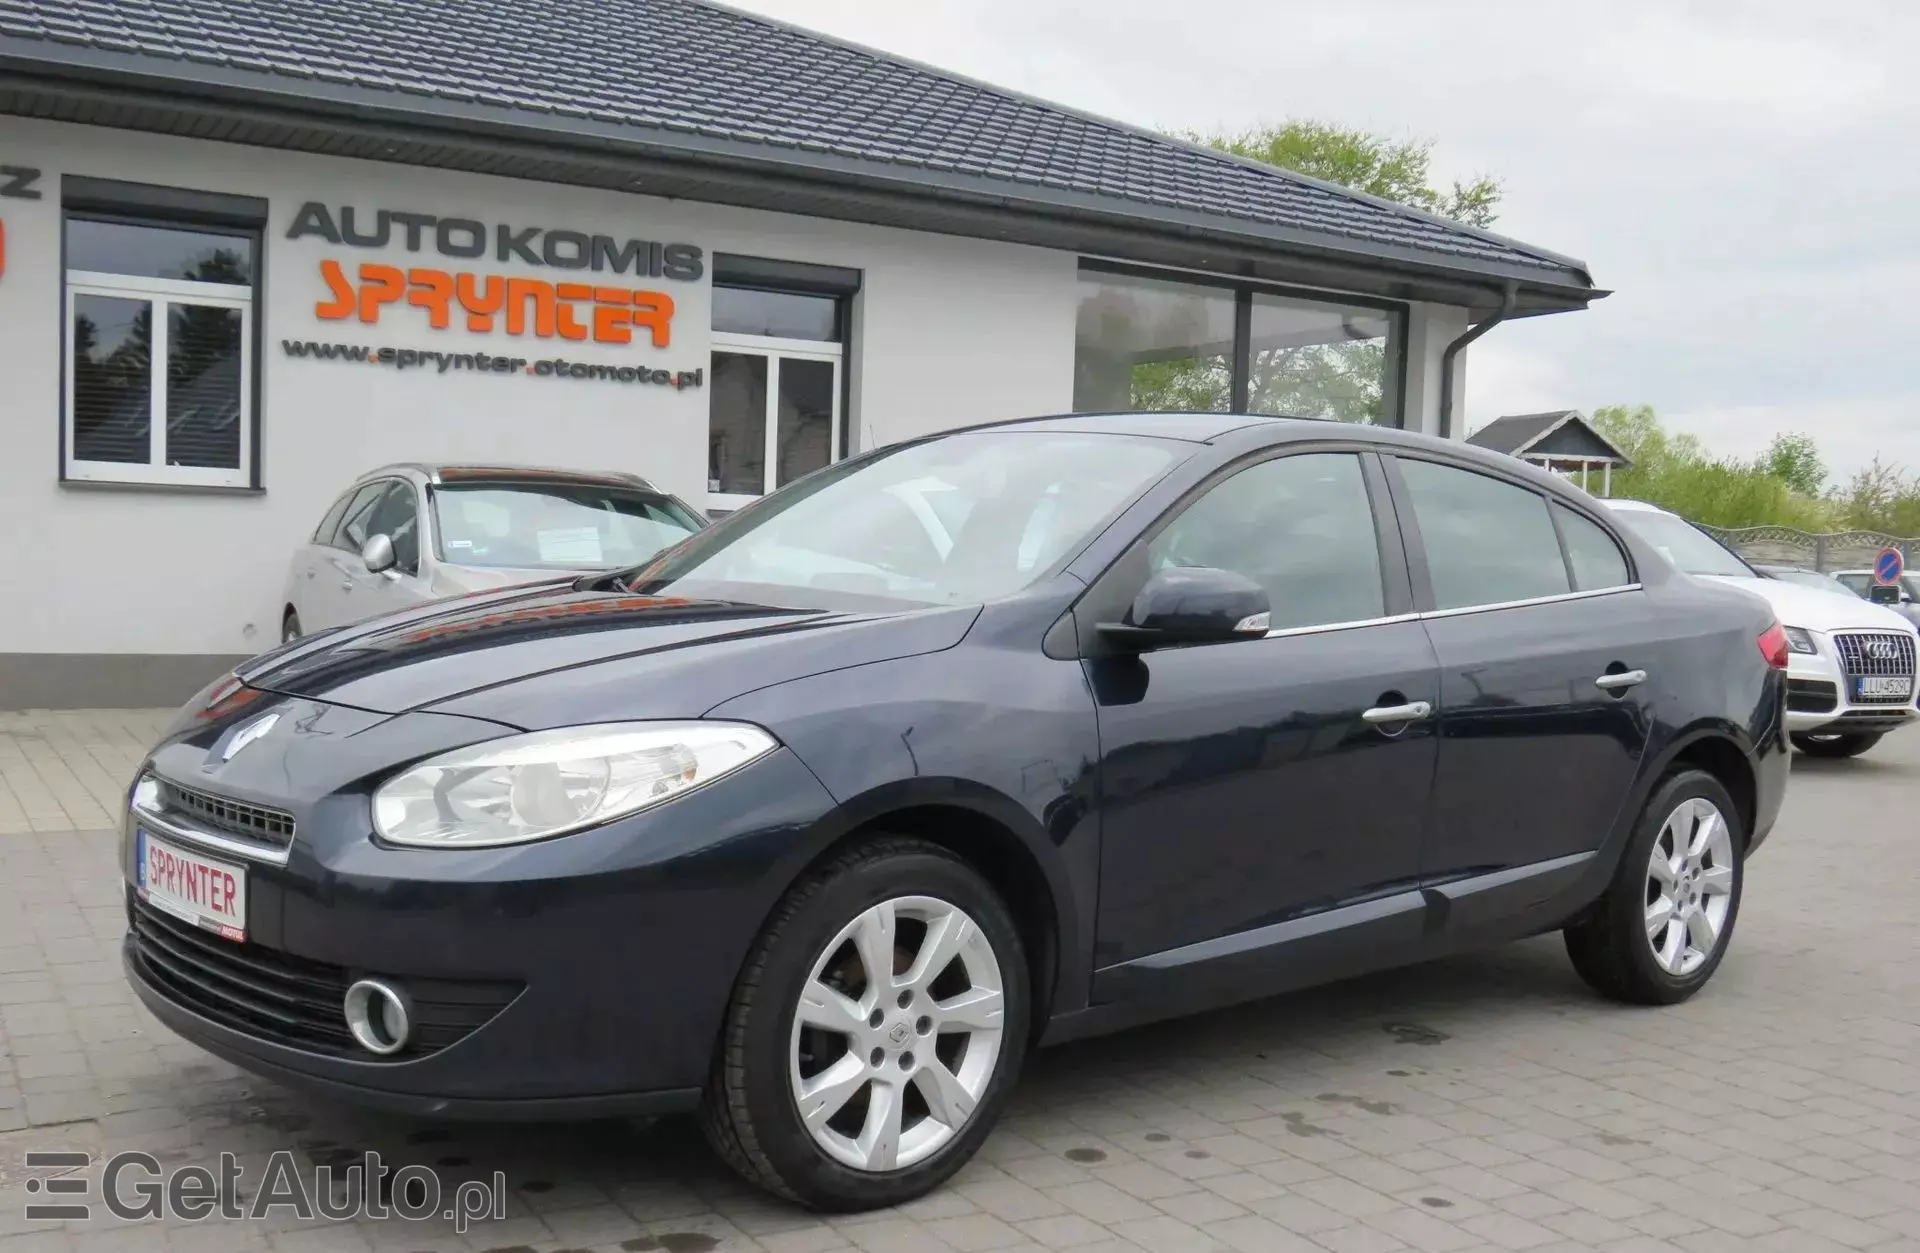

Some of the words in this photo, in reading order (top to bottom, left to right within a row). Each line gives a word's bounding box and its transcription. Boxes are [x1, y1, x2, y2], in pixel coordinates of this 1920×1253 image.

[285, 201, 487, 259] AUTO
[497, 223, 704, 282] KOMIS
[315, 259, 675, 348] SPRYNTER
[281, 339, 703, 392] www.sprynter.otomoto.pl
[149, 844, 237, 918] SPRYNTER
